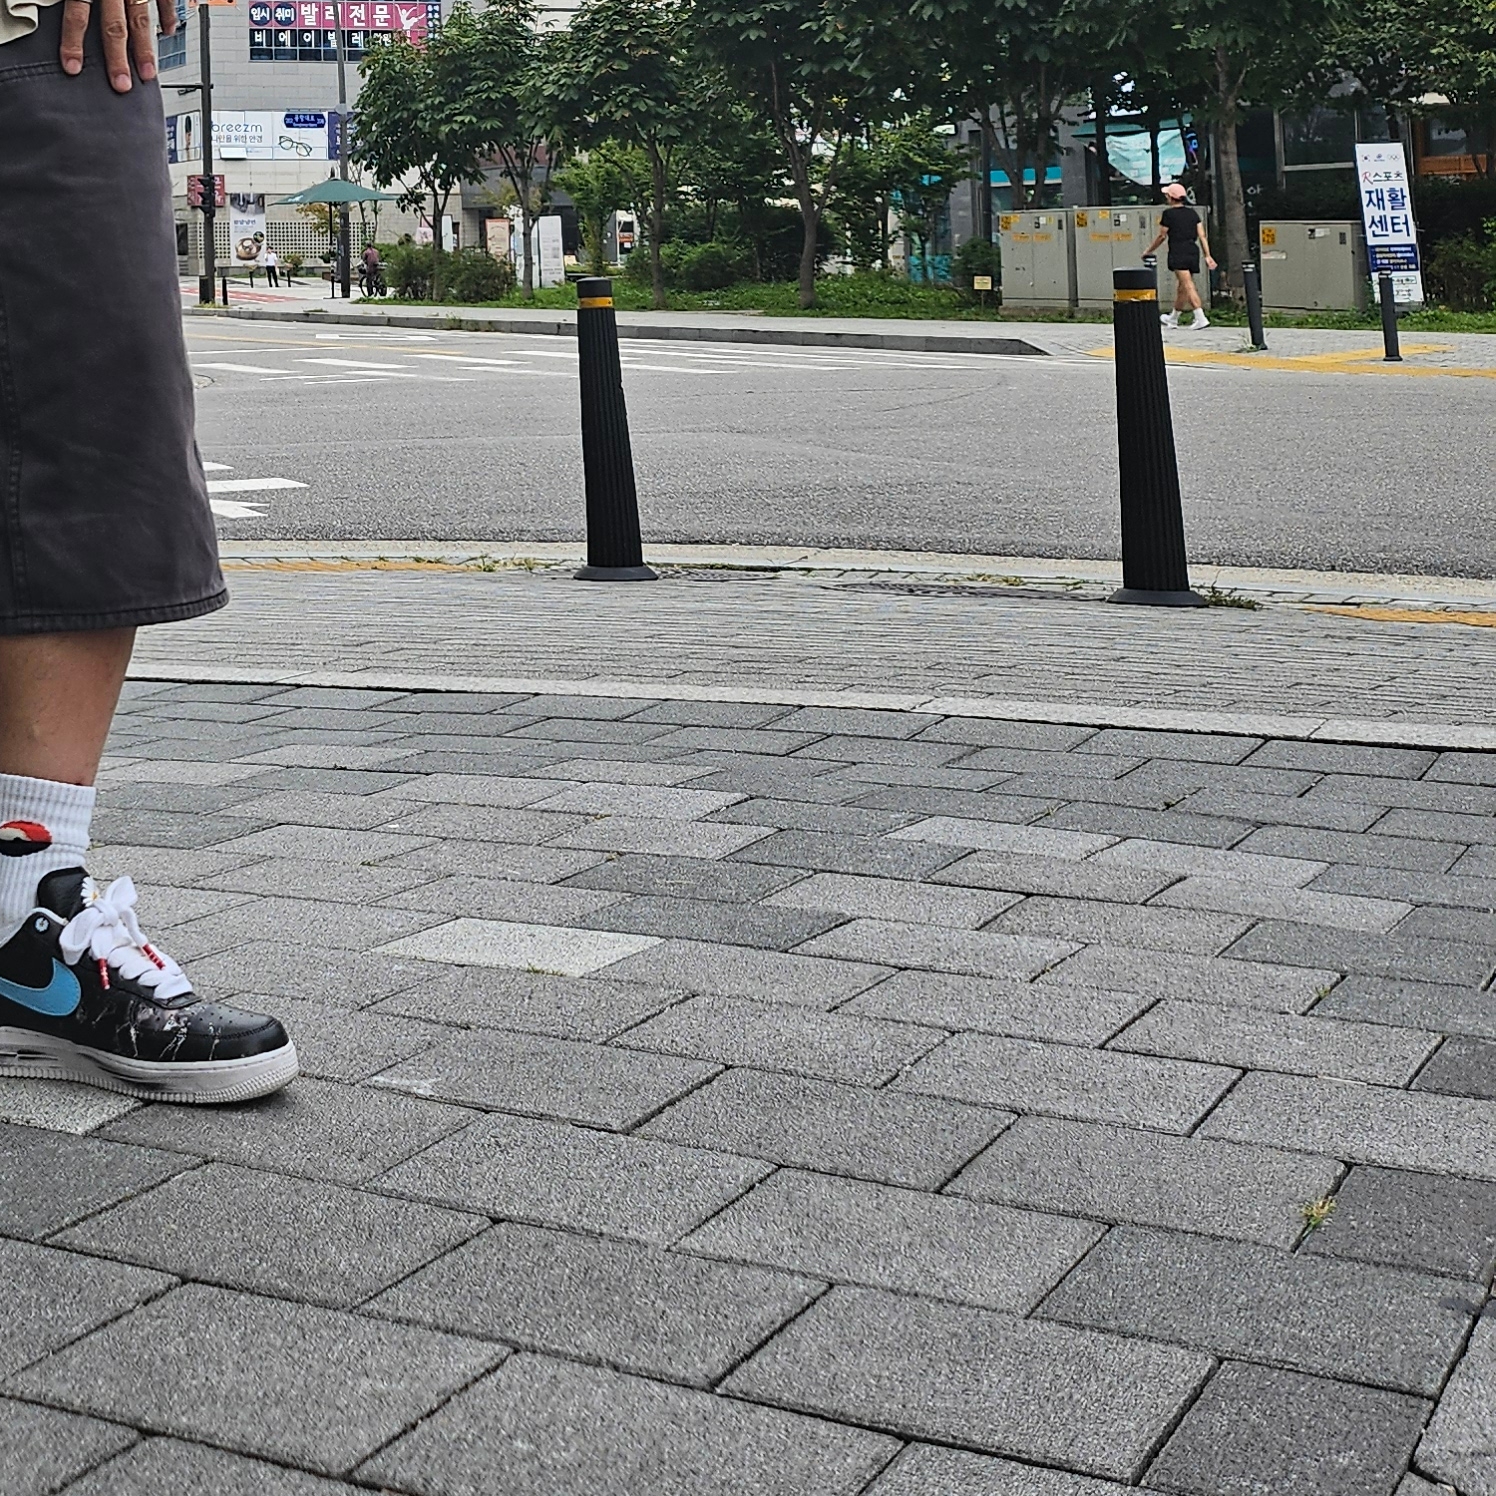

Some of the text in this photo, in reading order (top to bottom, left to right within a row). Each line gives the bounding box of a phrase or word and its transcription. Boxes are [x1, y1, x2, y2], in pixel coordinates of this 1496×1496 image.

[251, 7, 271, 22] 입시
[1364, 187, 1407, 212] 재활
[1368, 213, 1411, 238] 센터
